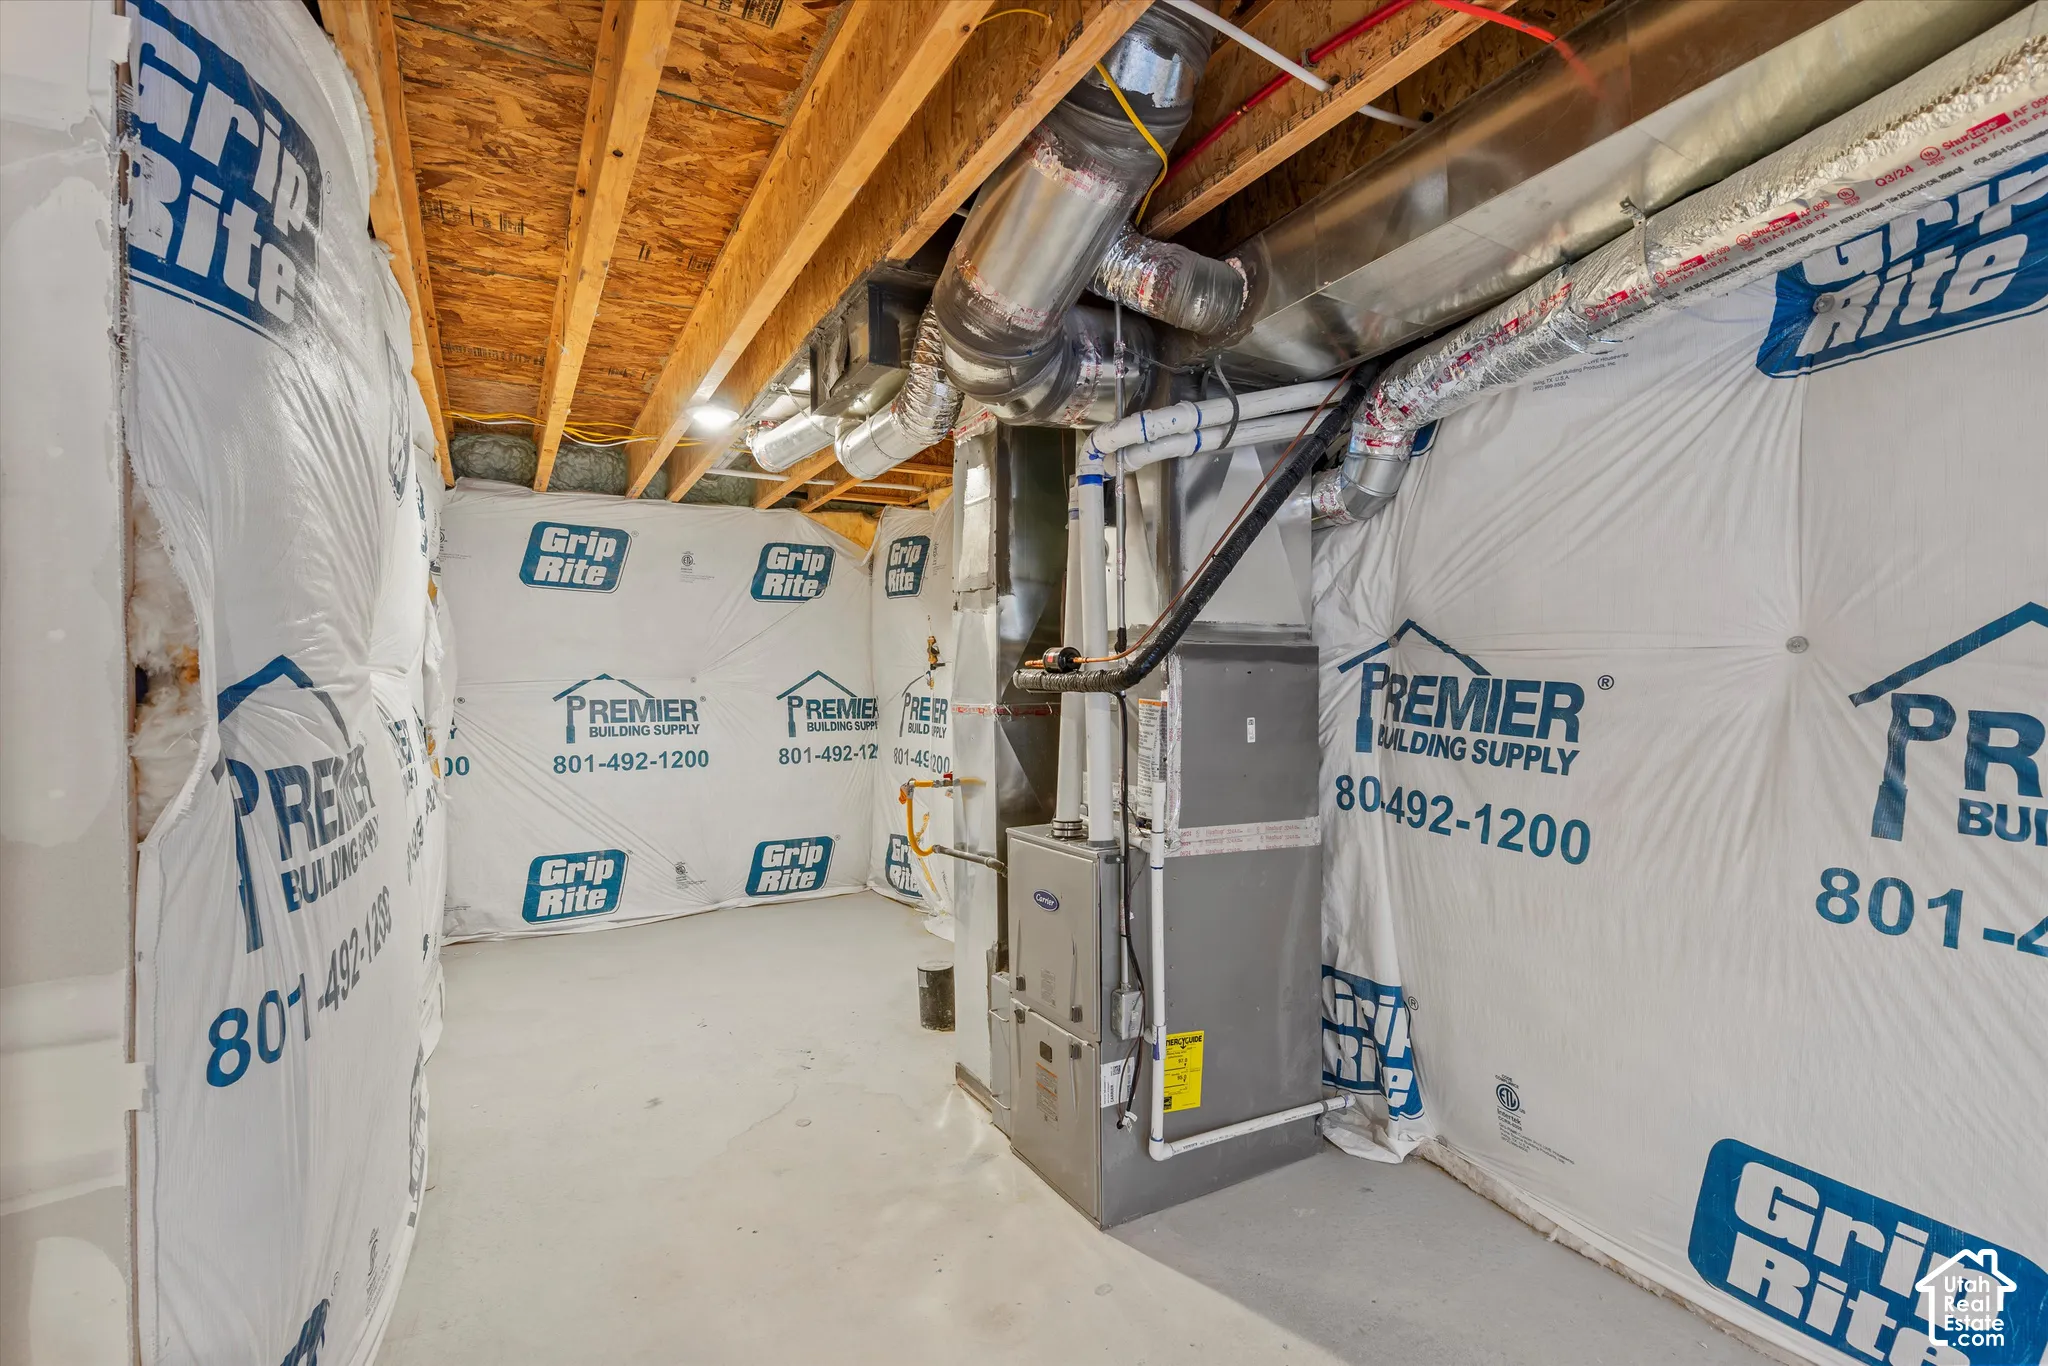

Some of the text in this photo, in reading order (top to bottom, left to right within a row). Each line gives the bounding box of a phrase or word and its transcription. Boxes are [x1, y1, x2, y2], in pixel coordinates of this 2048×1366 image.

[1875, 165, 1914, 187] Q3/24
[1796, 235, 2028, 359] Rite
[539, 527, 617, 563] Grip
[890, 541, 922, 568] Grip
[534, 555, 607, 586] Rite
[766, 546, 830, 577] Grip
[762, 571, 823, 598] Rite
[888, 568, 914, 592] Rite
[566, 695, 699, 744] PREMIER
[1355, 662, 1585, 753] PREMIER
[589, 723, 700, 738] BUILDING SUPPLY
[807, 721, 853, 732] BUILDING
[552, 750, 709, 774] 801-492-1200
[1377, 724, 1579, 776] BUILDING SUPPLY
[539, 855, 615, 886] Grip
[761, 841, 824, 869] Grip
[281, 838, 359, 913] BUILDING
[759, 865, 817, 893] Rite
[537, 886, 607, 918] Rite
[1035, 893, 1055, 906] Carrier
[1734, 1161, 2002, 1330] Grip
